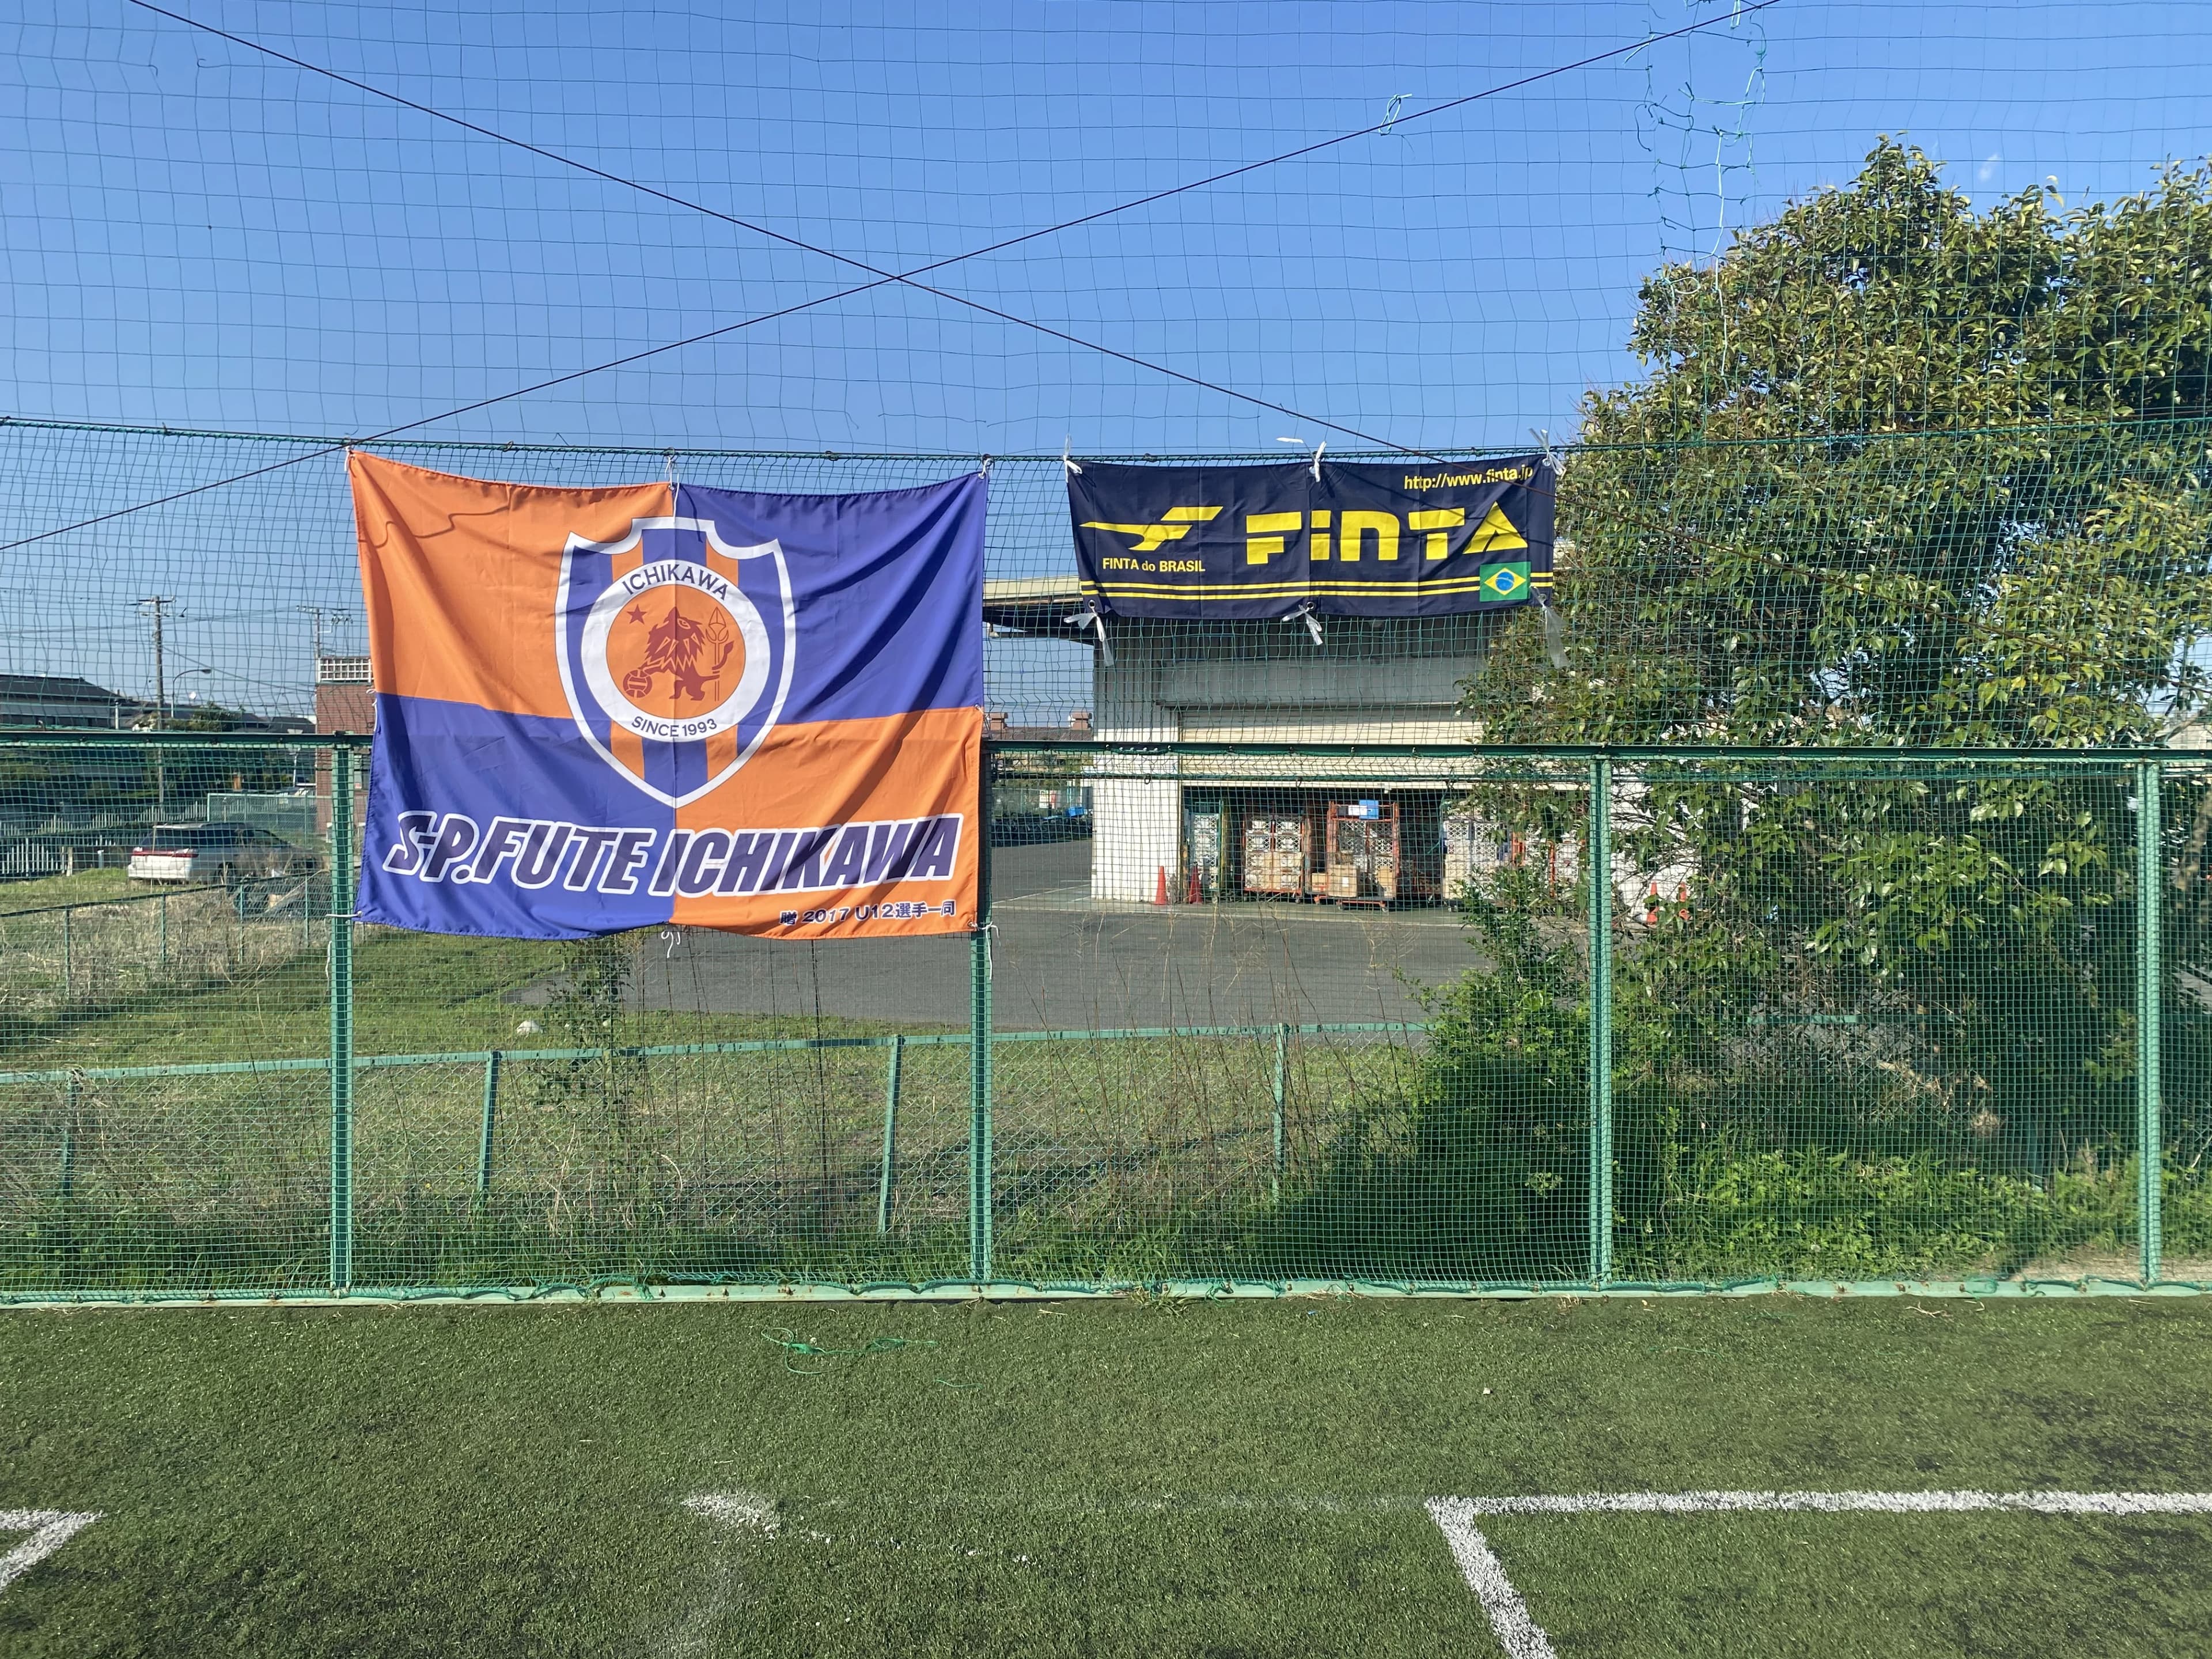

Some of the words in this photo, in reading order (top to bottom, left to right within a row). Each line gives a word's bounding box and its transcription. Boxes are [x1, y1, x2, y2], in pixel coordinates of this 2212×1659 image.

[1102, 558, 1139, 570] FINTA
[1141, 560, 1156, 571] do
[1159, 560, 1206, 572] BRASIL
[622, 563, 729, 601] ICHIKAWA
[631, 716, 679, 737] SINCE
[682, 718, 717, 737] 1993
[648, 813, 964, 897] ICHIKAWA
[801, 907, 850, 923] 2017
